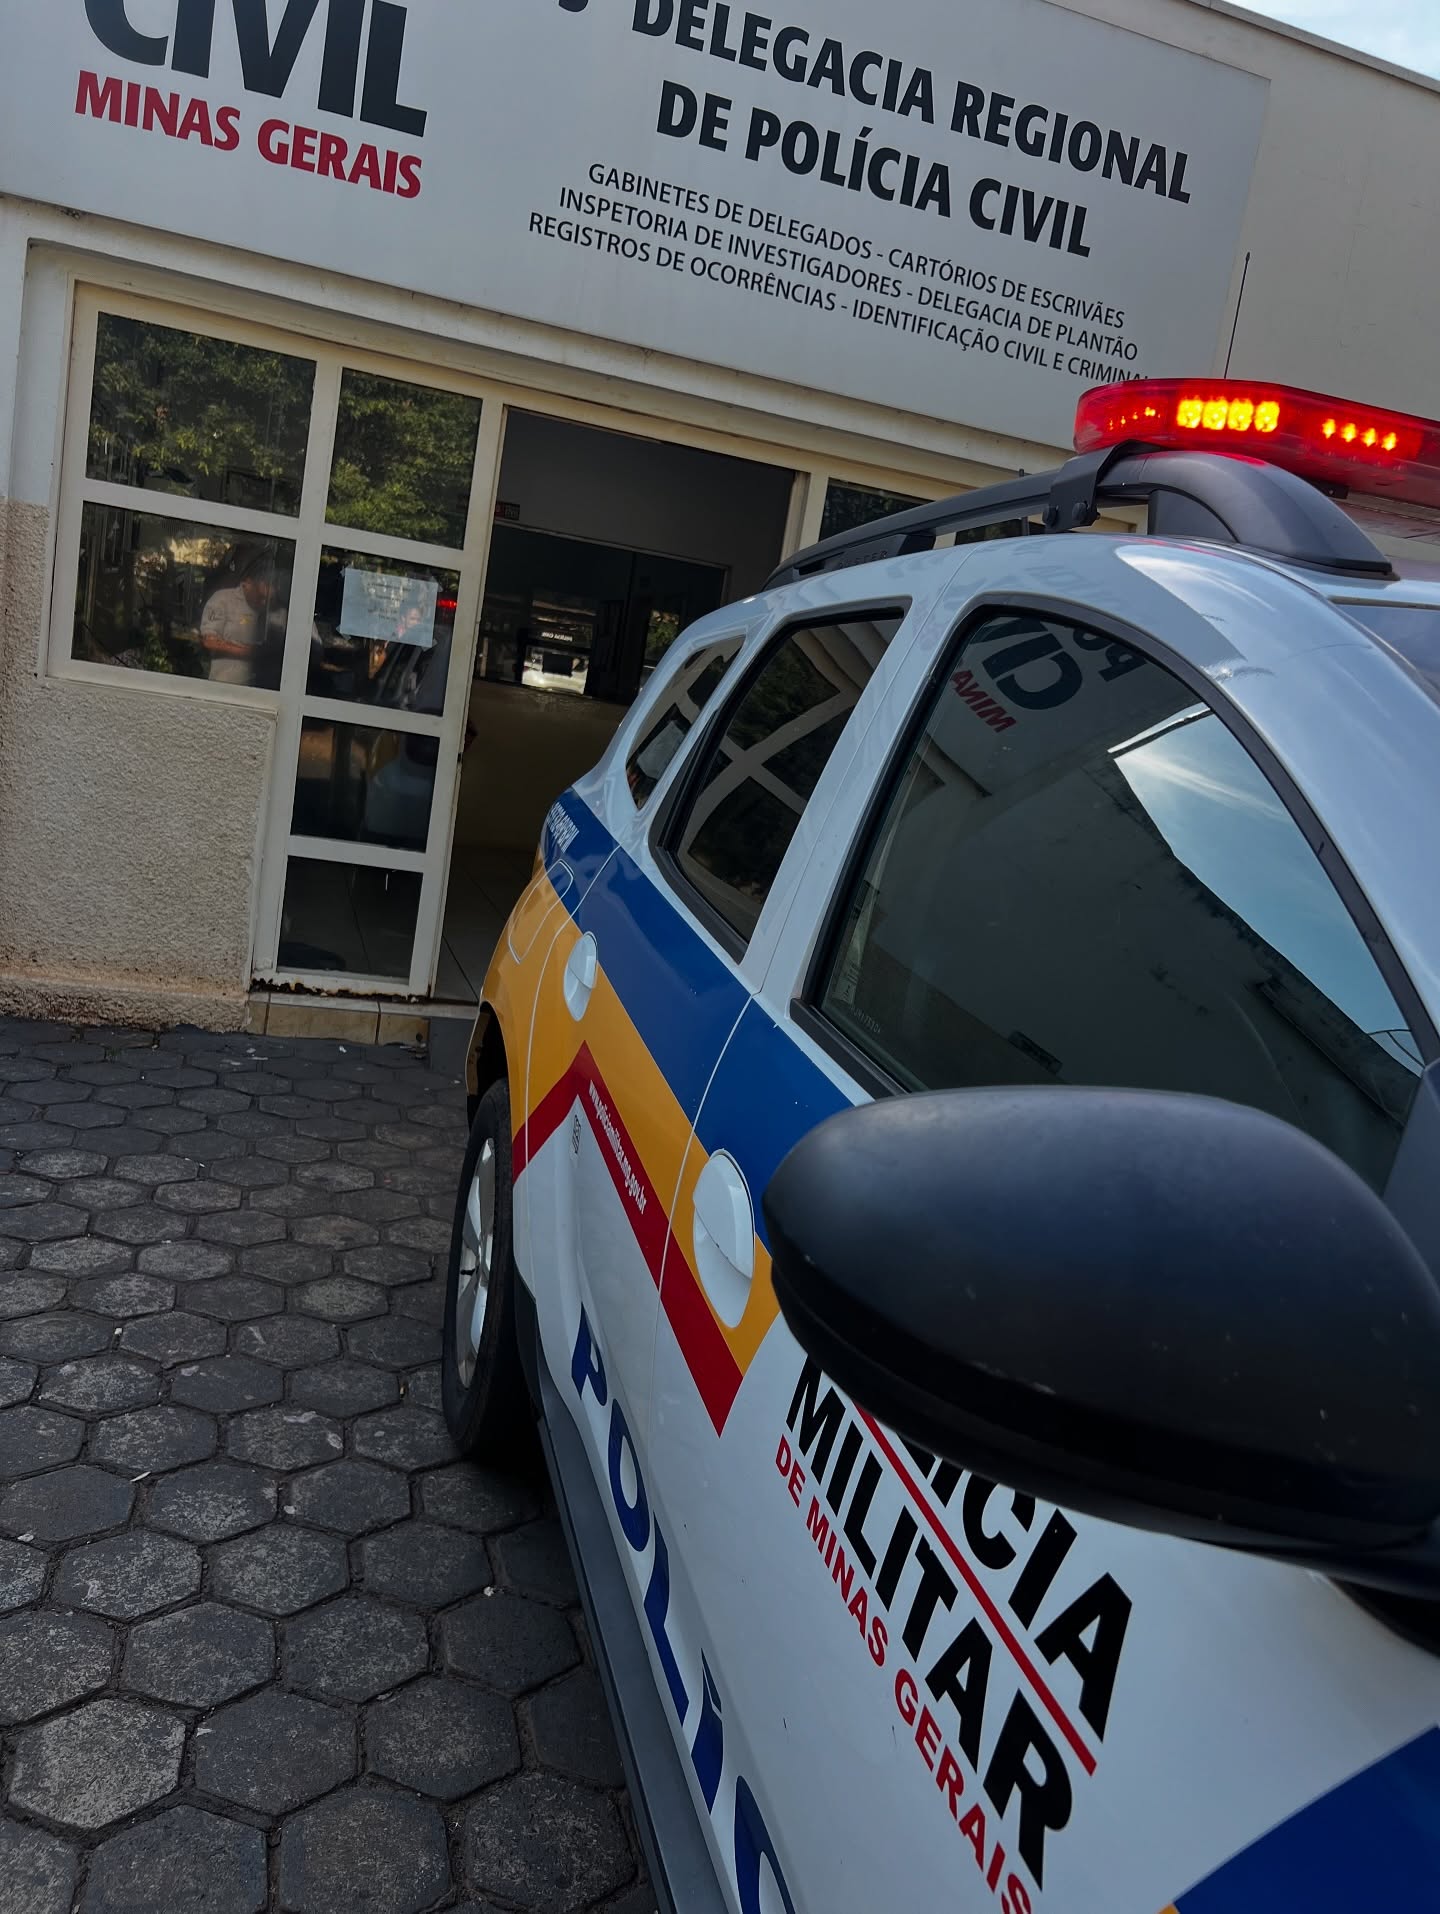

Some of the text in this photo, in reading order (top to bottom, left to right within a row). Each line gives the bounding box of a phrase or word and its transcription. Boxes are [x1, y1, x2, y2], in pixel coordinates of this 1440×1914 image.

[74, 69, 422, 199] MINAS GERAIS
[84, 0, 427, 137] CIVIL
[632, 0, 1191, 205] DELEGACIA REGIONAL
[588, 163, 710, 214] GABINETES
[714, 198, 744, 225] DE
[747, 207, 873, 260] DELEGADOS
[888, 248, 998, 294] CARTÓRIOS
[1001, 279, 1028, 303] DE
[1030, 287, 1125, 329] ESCRIVÃES
[656, 79, 1091, 259] DE POLÍCIA CIVIL
[529, 211, 651, 263] REGISTROS
[655, 246, 686, 273] DE
[690, 256, 837, 311] OCORRÊNCIAS
[852, 299, 1000, 354] IDENTIFICAÇÃO
[1003, 339, 1048, 368] CIVIL
[1052, 351, 1065, 371] E
[1067, 356, 1148, 384] CRIMIN
[559, 186, 688, 242] INSPETORIA
[694, 224, 724, 251] DE
[727, 233, 903, 299] INVESTIGADORES
[917, 286, 1022, 332] DELEGACIA
[1026, 315, 1053, 339] DE
[1055, 323, 1138, 361] PLANTÃO
[775, 1433, 1031, 1914] DE MINAS GERAIS
[786, 1354, 1072, 1892] MILITAR
